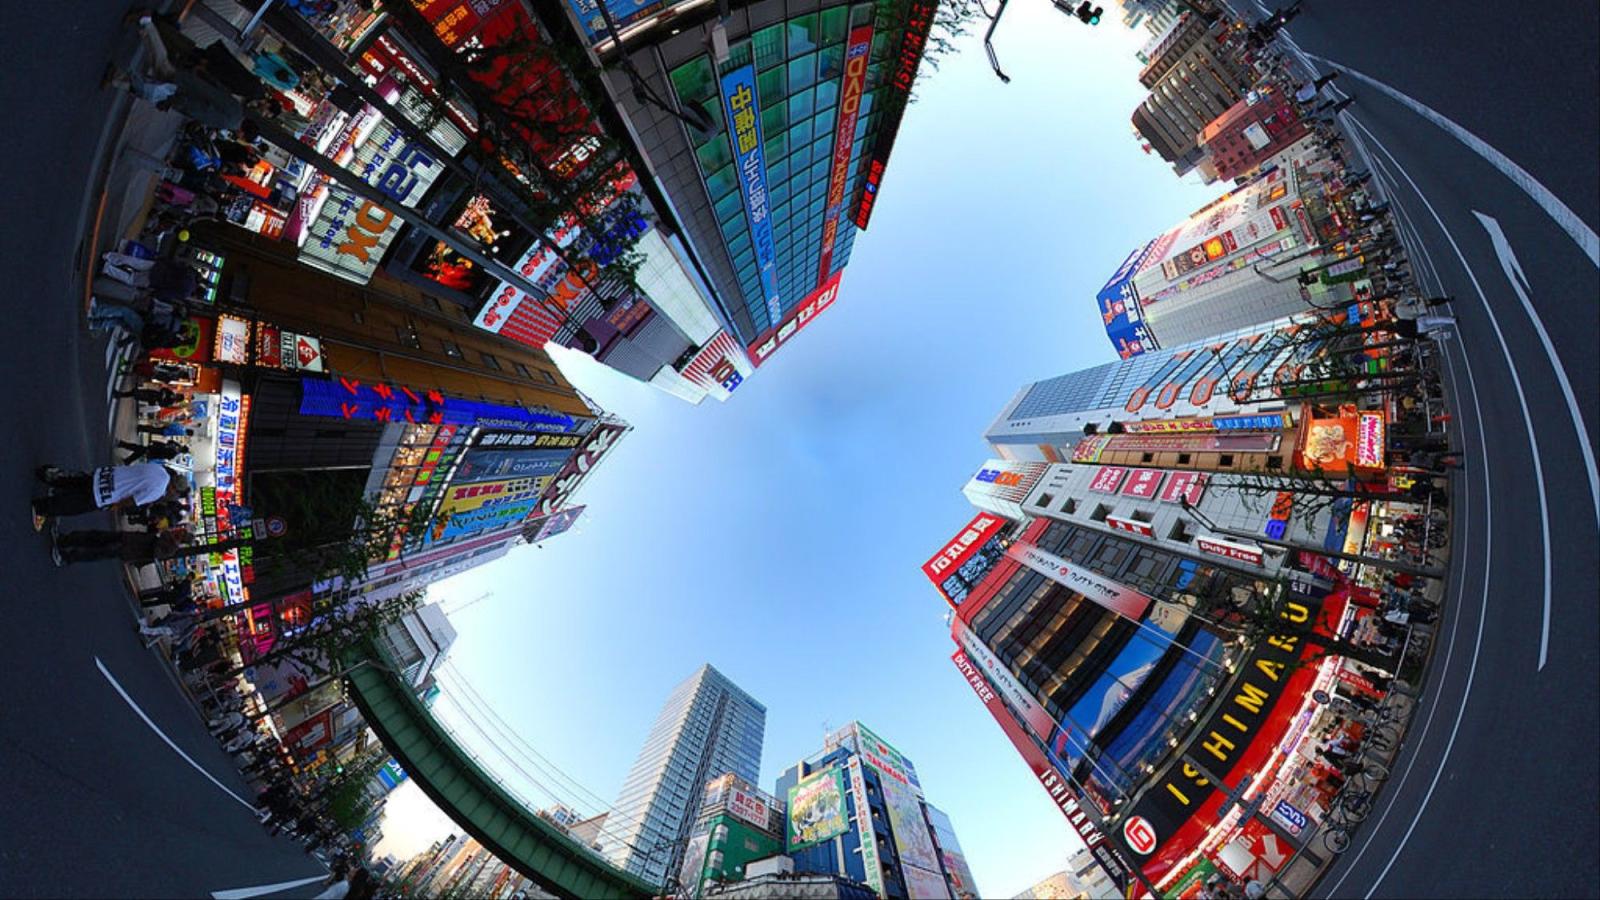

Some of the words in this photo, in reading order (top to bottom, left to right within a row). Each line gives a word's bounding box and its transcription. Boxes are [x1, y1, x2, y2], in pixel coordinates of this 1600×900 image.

[842, 55, 865, 113] DVD
[378, 126, 408, 154] ome
[316, 214, 347, 251] Store
[540, 427, 617, 516] オノデン
[1198, 539, 1230, 555] Duty
[1227, 547, 1260, 563] Free
[951, 653, 977, 678] DUTY
[967, 674, 996, 704] FREE
[1163, 600, 1312, 807] ISHIMARU
[1036, 767, 1107, 847] ISHIMARU
